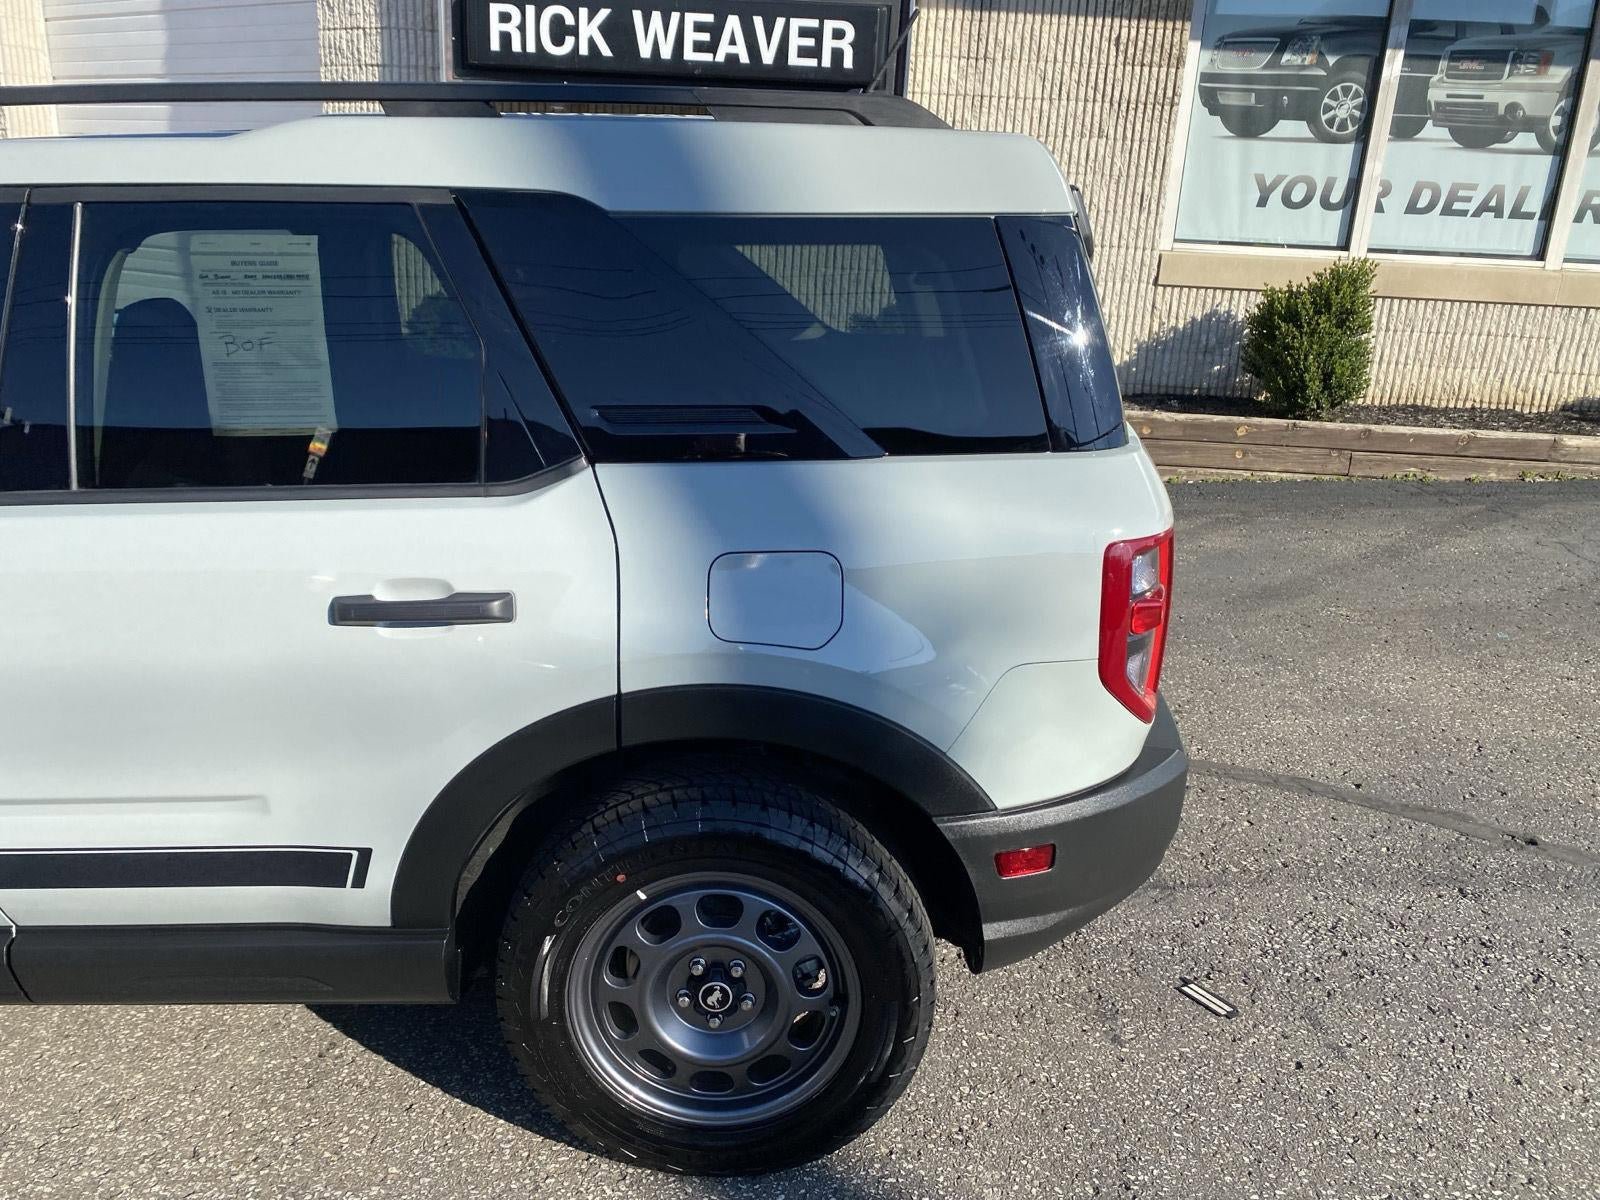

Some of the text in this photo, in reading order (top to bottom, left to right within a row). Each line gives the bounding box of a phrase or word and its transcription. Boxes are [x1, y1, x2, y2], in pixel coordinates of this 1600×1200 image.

[489, 2, 856, 69] RICK WEAVER
[1403, 180, 1600, 225] DEALR
